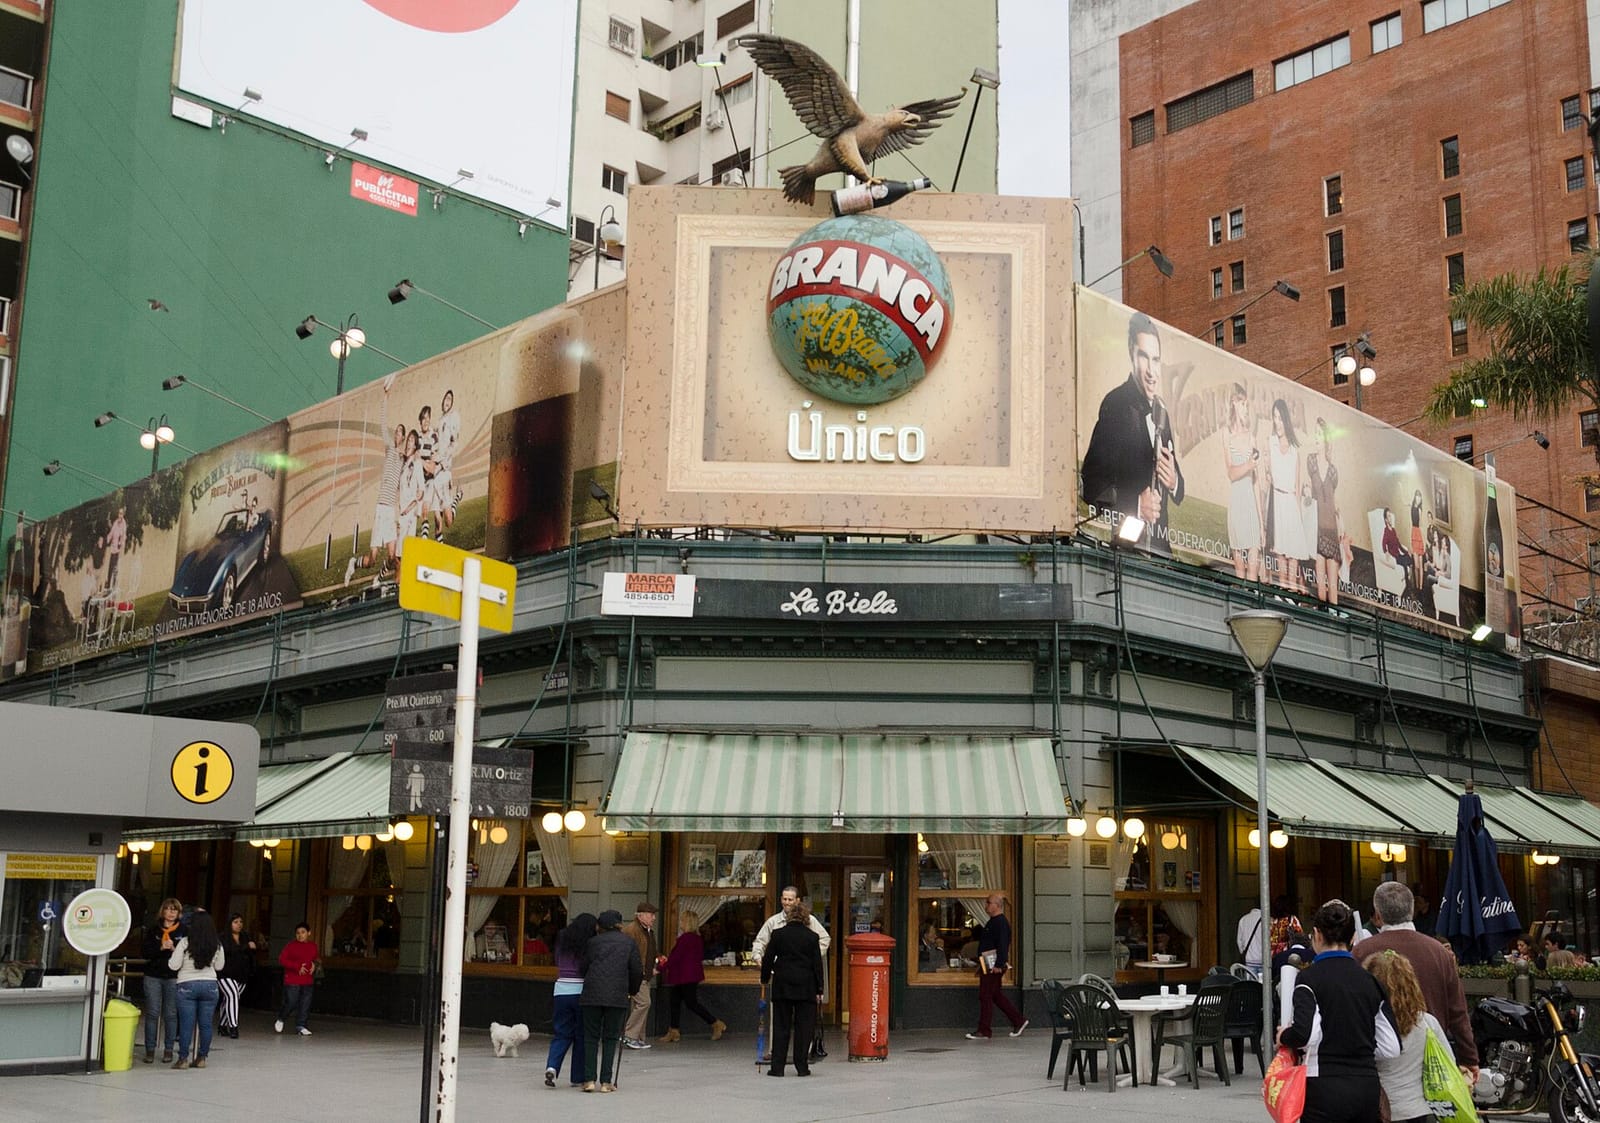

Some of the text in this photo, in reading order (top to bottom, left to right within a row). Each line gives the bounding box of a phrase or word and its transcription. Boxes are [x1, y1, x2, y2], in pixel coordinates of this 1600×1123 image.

[354, 178, 417, 207] PUBLICITAR
[770, 246, 944, 351] BRANCA
[788, 400, 926, 462] Único
[628, 574, 673, 584] MARCA
[626, 583, 674, 593] URBANA
[781, 587, 898, 616] La Biela
[1380, 592, 1391, 606] DE
[195, 606, 234, 625] MENORES
[235, 602, 247, 617] DE
[248, 599, 256, 613] 18
[409, 694, 442, 708] Quintana
[429, 728, 445, 742] 600
[504, 804, 528, 817] 1800
